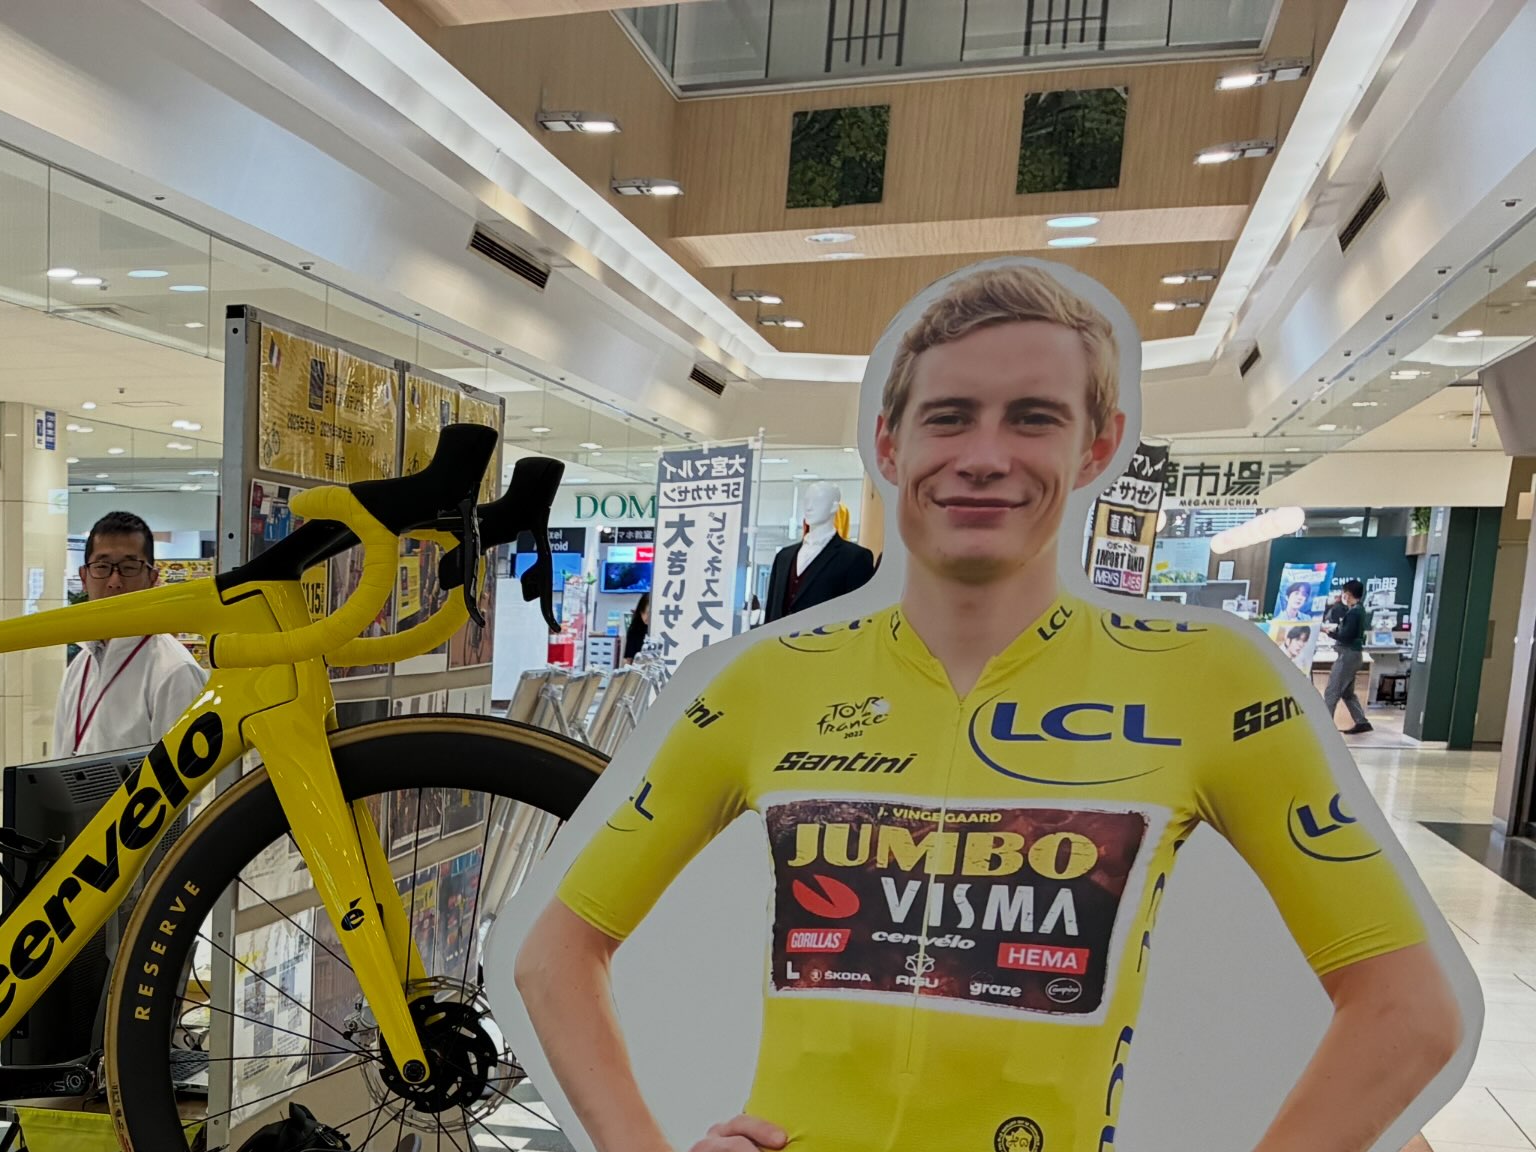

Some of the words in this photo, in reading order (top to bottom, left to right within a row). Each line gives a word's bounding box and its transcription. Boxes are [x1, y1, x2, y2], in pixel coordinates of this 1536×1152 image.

[575, 494, 656, 519] DOM
[1178, 498, 1222, 507] MEGANE
[1036, 604, 1074, 642] LCL
[817, 713, 889, 736] france
[990, 701, 1183, 747] LCL
[773, 751, 919, 775] Santini
[894, 808, 1003, 825] VINGEGAARD
[788, 823, 1099, 880] JUMBO
[880, 876, 1080, 937] VISMA
[134, 878, 202, 1022] RESERVE
[790, 932, 843, 950] GORILLAS
[871, 930, 977, 951] cervélo
[1007, 947, 1080, 970] HEMA
[895, 974, 940, 989] AGU
[969, 980, 1023, 998] graze
